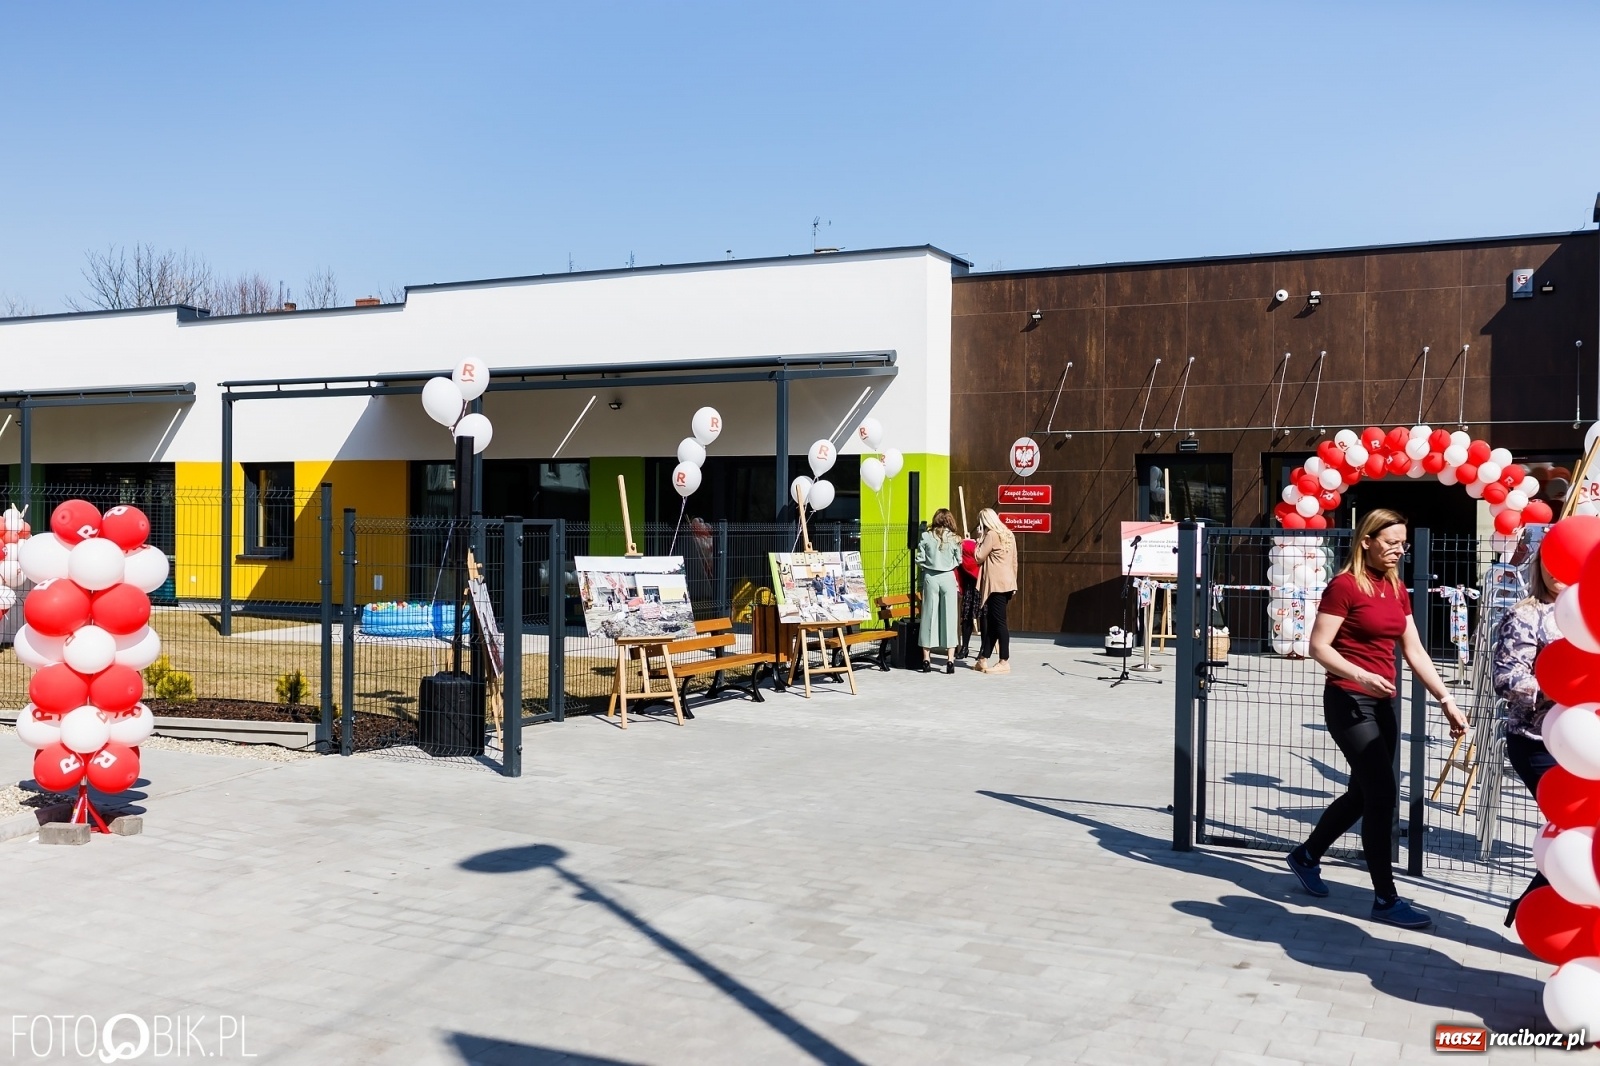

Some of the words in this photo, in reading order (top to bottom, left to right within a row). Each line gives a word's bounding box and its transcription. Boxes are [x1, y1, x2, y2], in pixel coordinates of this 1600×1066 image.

[462, 363, 475, 377] R
[710, 416, 719, 428] R
[860, 427, 867, 437] R
[818, 444, 829, 457] R
[1338, 441, 1347, 450] R
[1371, 440, 1380, 449] R
[676, 471, 686, 483] R
[1590, 482, 1600, 496] R
[77, 525, 98, 539] R
[59, 754, 80, 775] R
[94, 750, 117, 769] R
